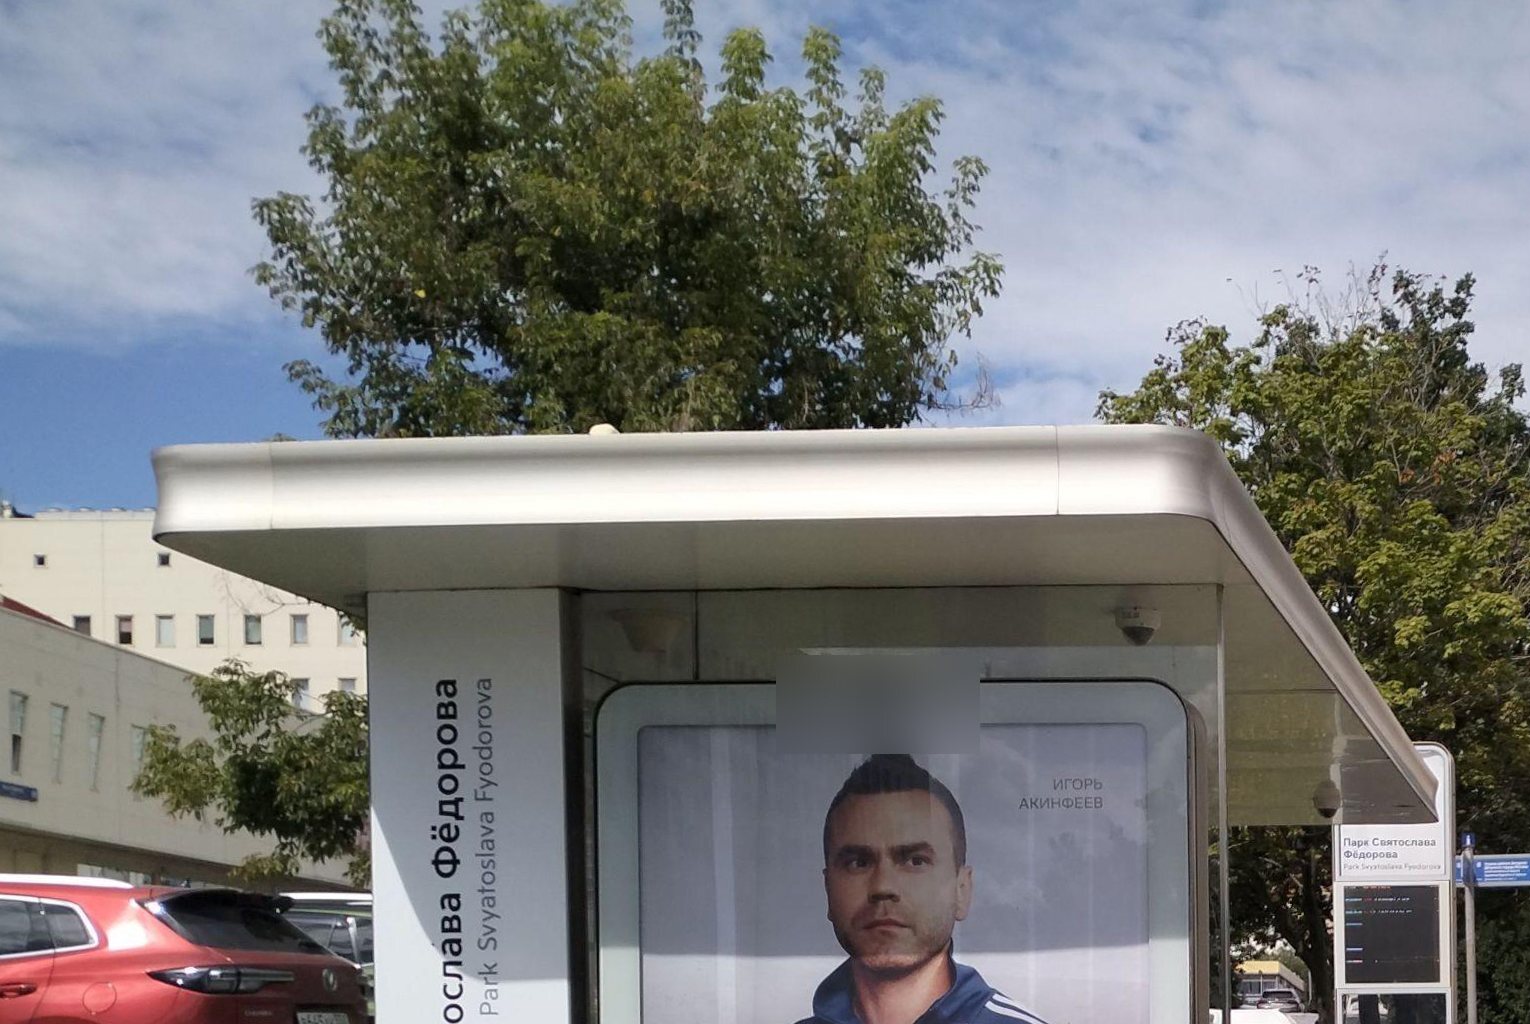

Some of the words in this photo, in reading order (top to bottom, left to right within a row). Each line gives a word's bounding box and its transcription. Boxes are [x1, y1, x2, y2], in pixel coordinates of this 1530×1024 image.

[473, 677, 498, 802] Fyodorova
[431, 678, 466, 879] Фёдорова
[1053, 778, 1103, 790] ИГОРЬ
[1019, 797, 1103, 809] АКИНФЕЕВ
[1343, 837, 1369, 848] Парк
[1372, 837, 1436, 847] Святослава
[1343, 850, 1398, 860] Фёдорова
[475, 811, 501, 952] Svyatoslava
[479, 961, 499, 1016] Park
